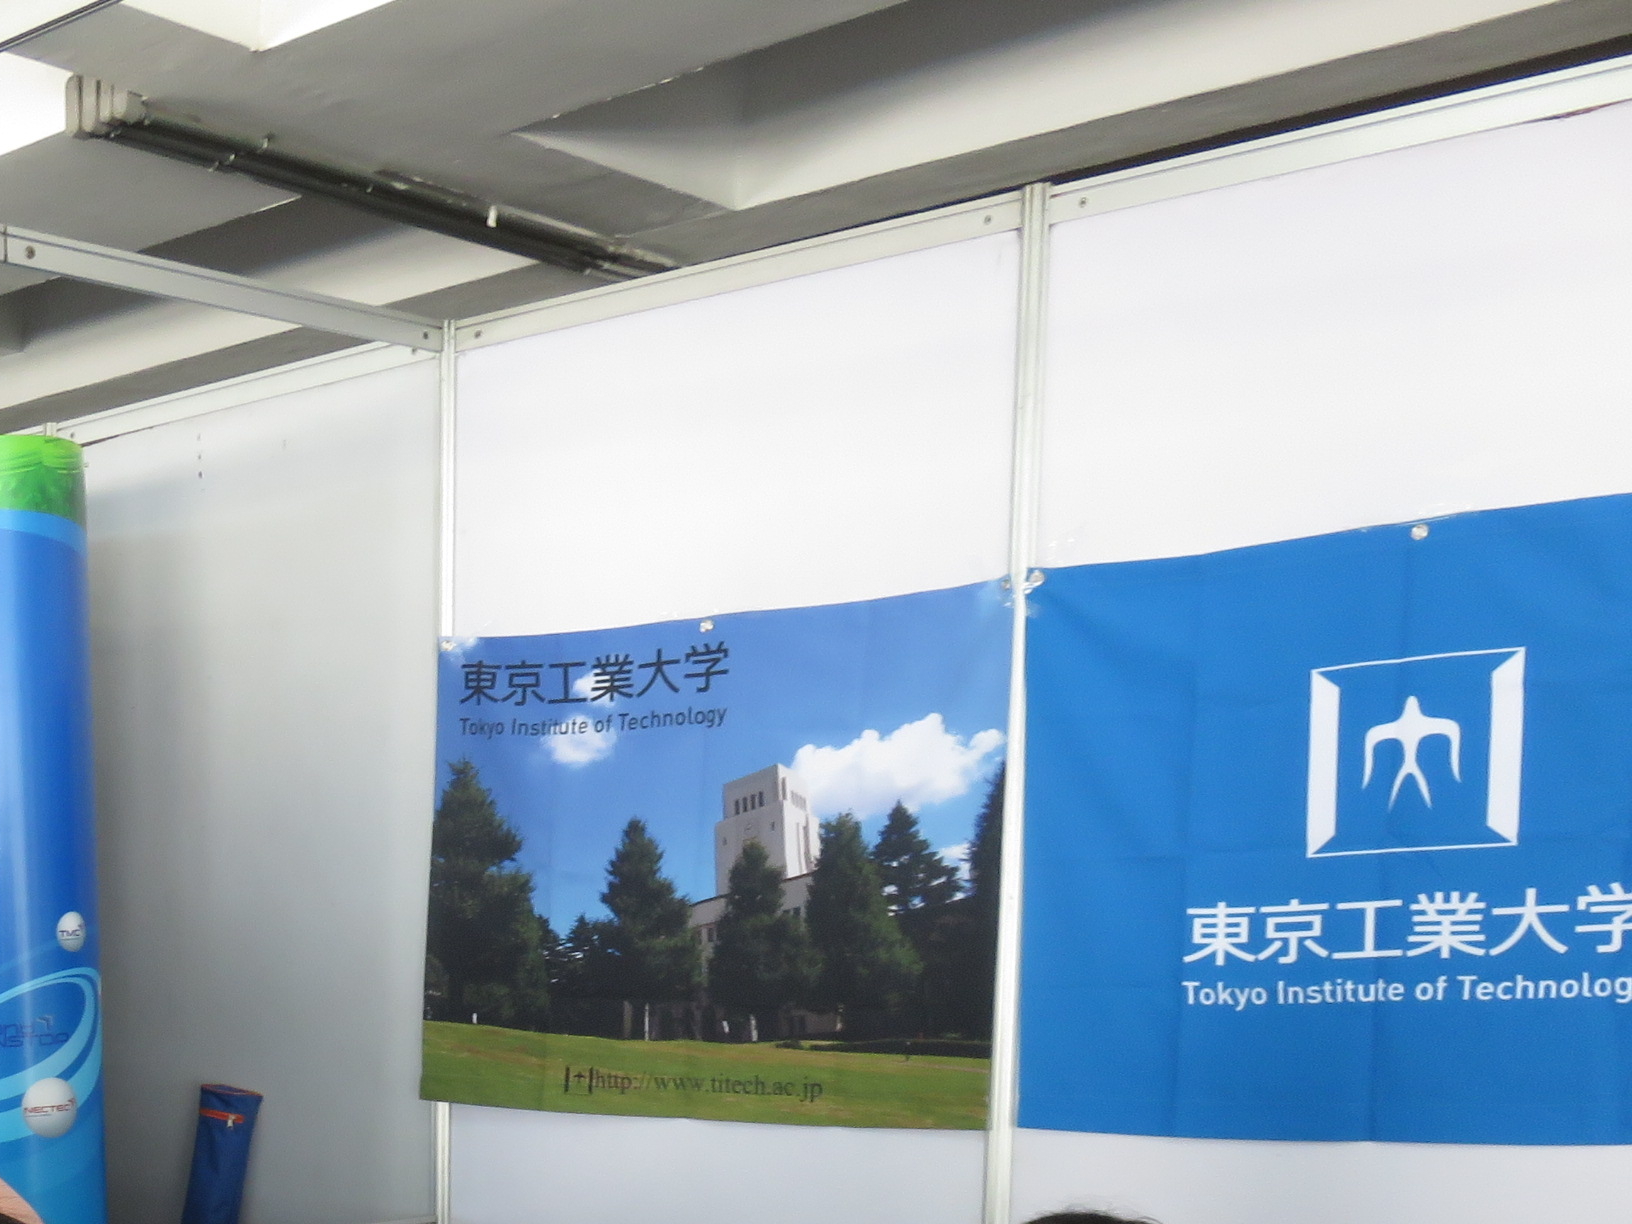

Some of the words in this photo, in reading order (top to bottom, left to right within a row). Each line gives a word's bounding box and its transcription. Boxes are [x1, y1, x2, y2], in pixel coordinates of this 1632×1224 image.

[459, 640, 730, 706] 東京工業大学
[459, 717, 505, 741] Tokyo
[511, 716, 589, 737] Institute
[594, 716, 613, 734] of
[619, 706, 728, 732] Technology
[1182, 882, 1632, 966] 東京工業大学
[1181, 980, 1268, 1012] Tokyo
[1276, 977, 1405, 1005] Institute
[1414, 975, 1448, 1001] of
